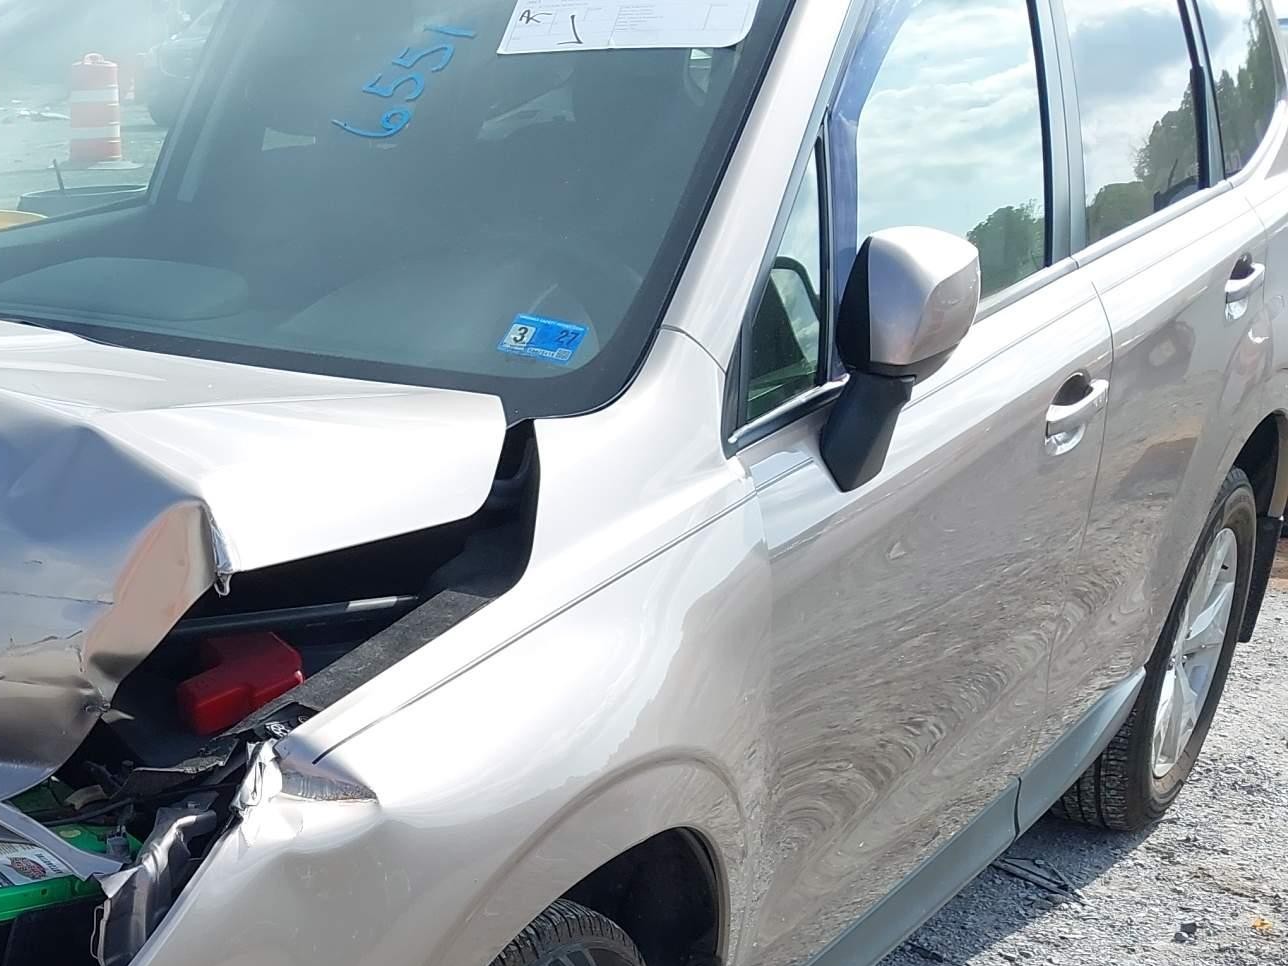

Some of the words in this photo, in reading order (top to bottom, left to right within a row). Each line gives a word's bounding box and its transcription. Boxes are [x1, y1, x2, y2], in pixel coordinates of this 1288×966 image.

[331, 23, 478, 139] 6551
[512, 326, 529, 344] 3
[554, 328, 581, 348] 27
